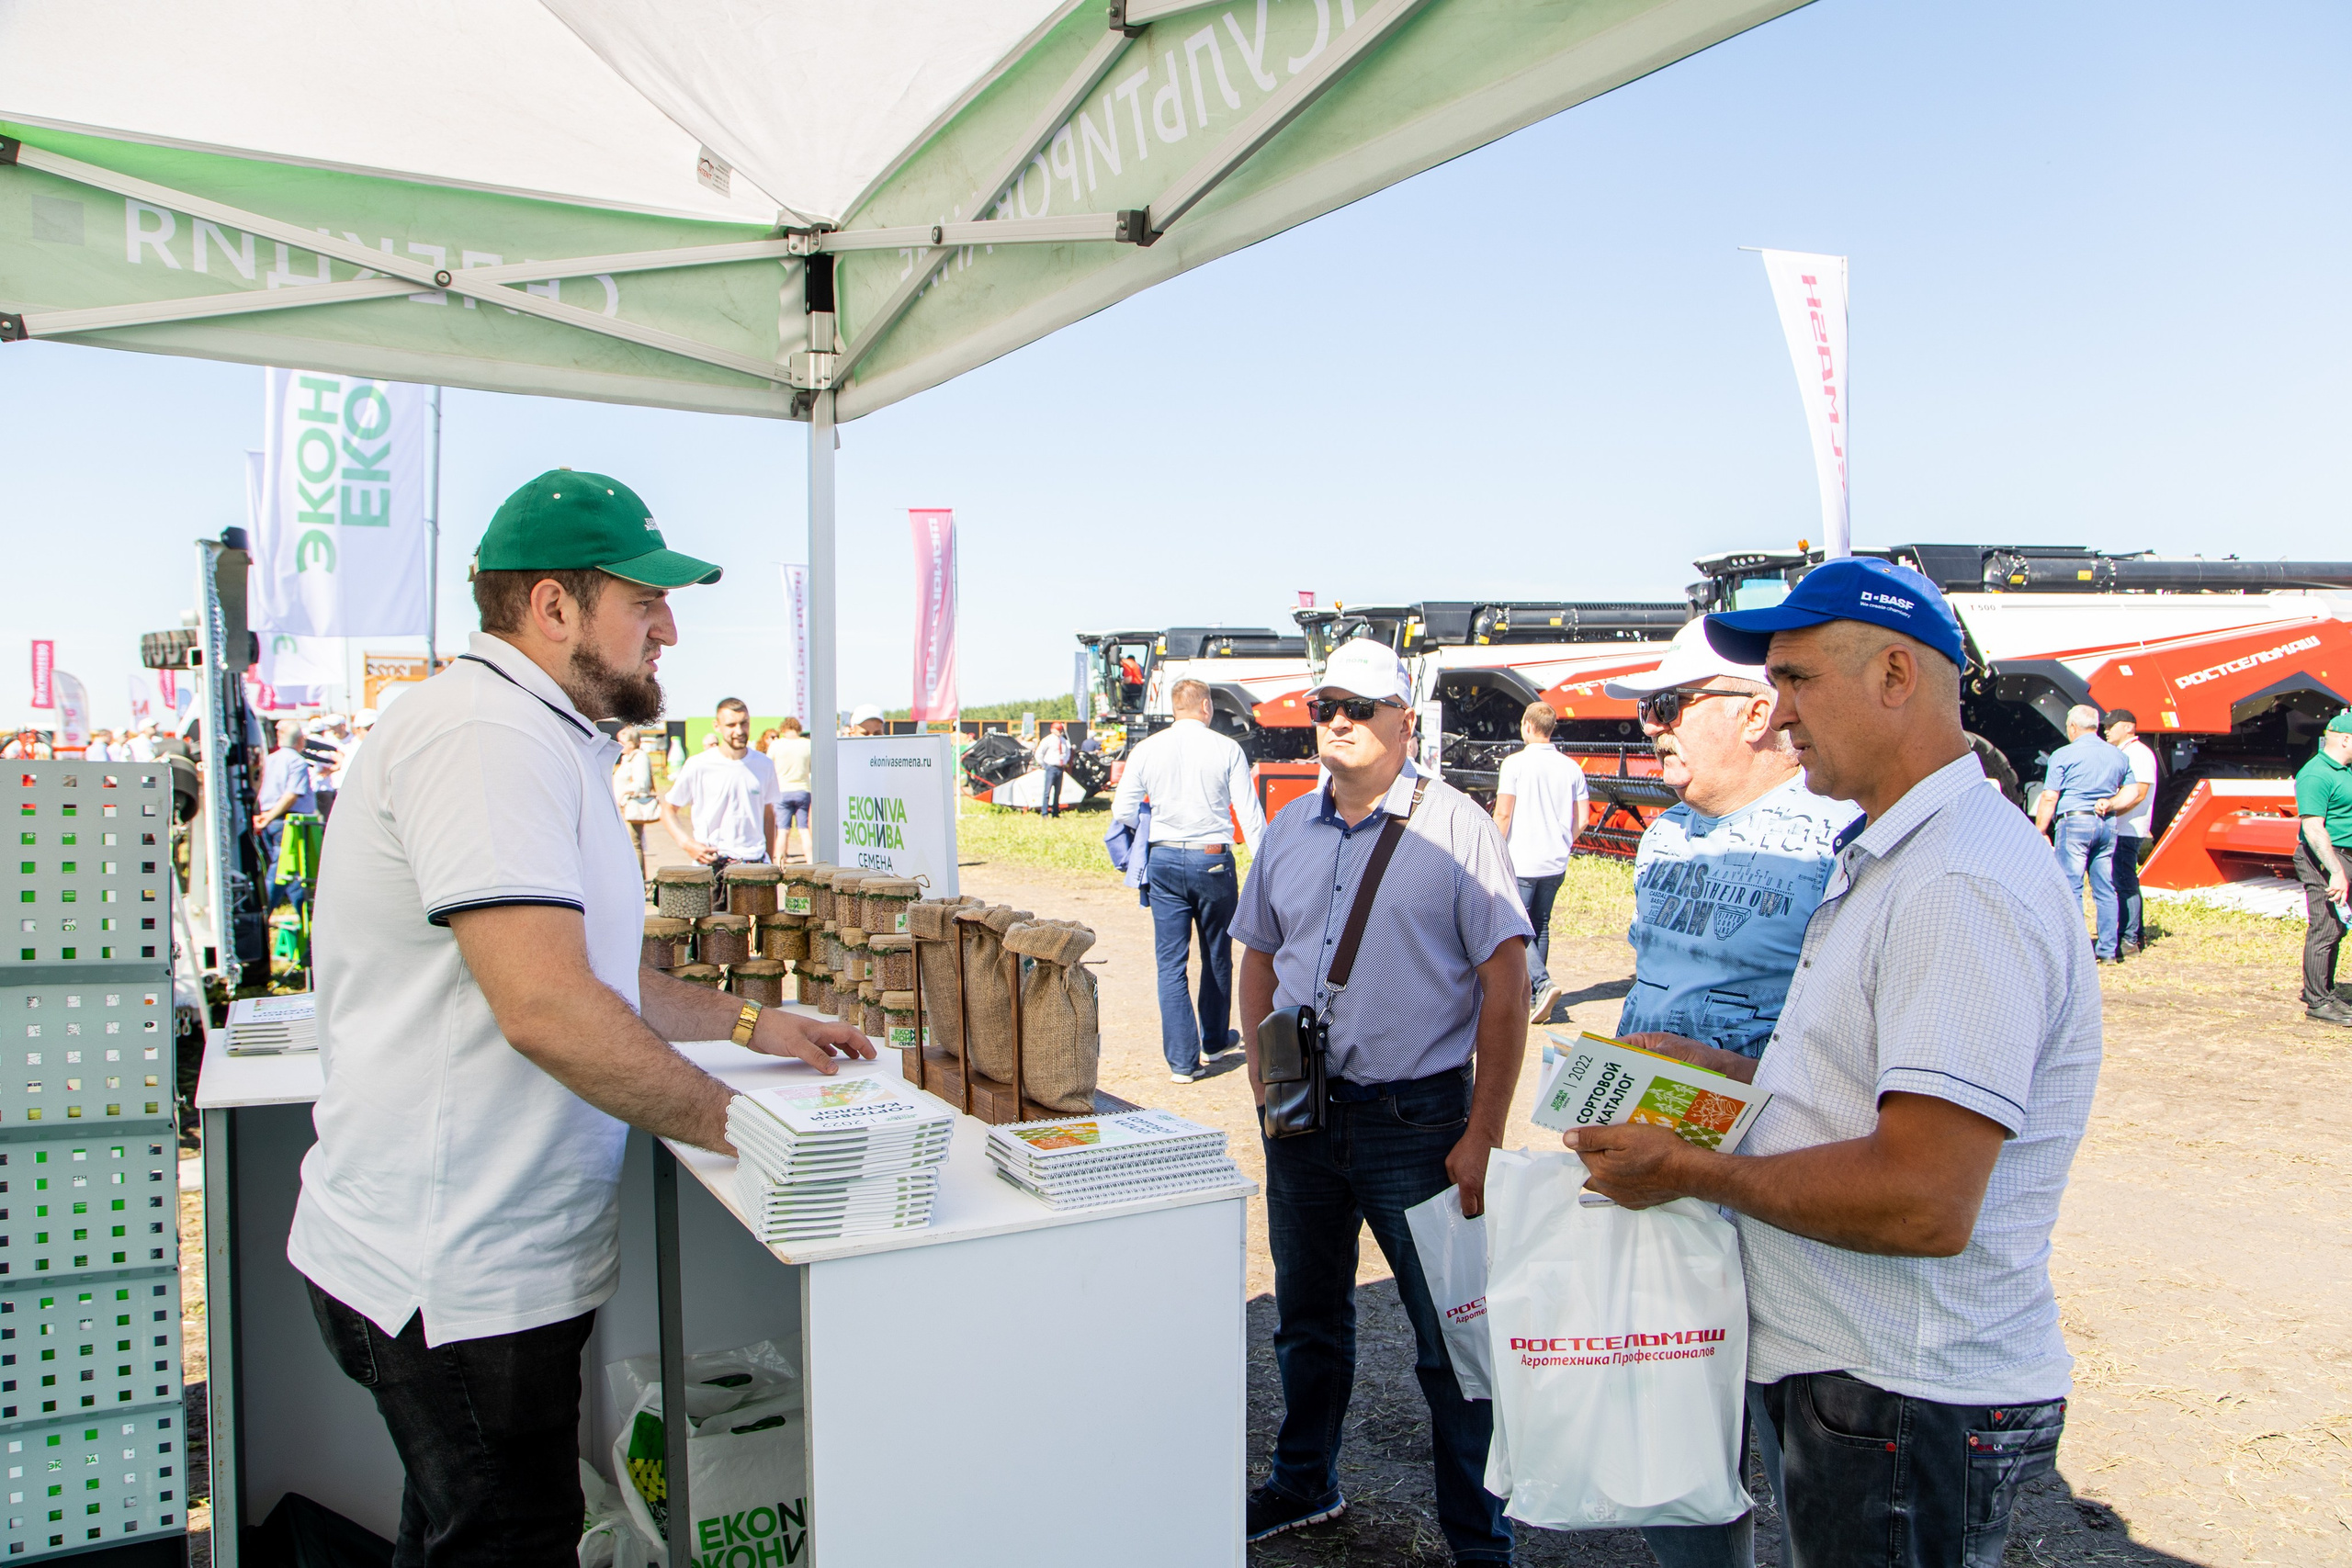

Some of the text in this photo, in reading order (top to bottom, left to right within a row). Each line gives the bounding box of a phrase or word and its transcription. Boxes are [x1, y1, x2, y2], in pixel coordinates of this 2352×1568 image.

[1879, 593, 1916, 611] BASF
[1886, 606, 1912, 619] chemistry
[2174, 635, 2322, 690] РОСТСЕЛЬМАШ
[869, 755, 932, 768] ekonivasemena.ru
[848, 795, 909, 824] EKONIVA
[842, 820, 905, 851] ЭКОНИВА
[857, 852, 894, 872] СЕМЕНА
[1704, 881, 1793, 919] THEIR OWN
[1654, 894, 1715, 937] RAW
[890, 1033, 927, 1042] ЭКОНИА
[894, 1028, 928, 1036] EKONA
[1567, 1055, 1594, 1082] 2022
[1576, 1062, 1623, 1125] СОРТОВОЙ
[1596, 1073, 1635, 1126] КАТАЛОГ
[809, 1105, 915, 1121] СОРТОВОЙ
[817, 1101, 901, 1115] КАТАЛОГ
[822, 1119, 864, 1128] 2022
[1510, 1328, 1726, 1353] РОСТСЕЛЬМАШ
[1521, 1346, 1715, 1370] Агротехника Профессионалов
